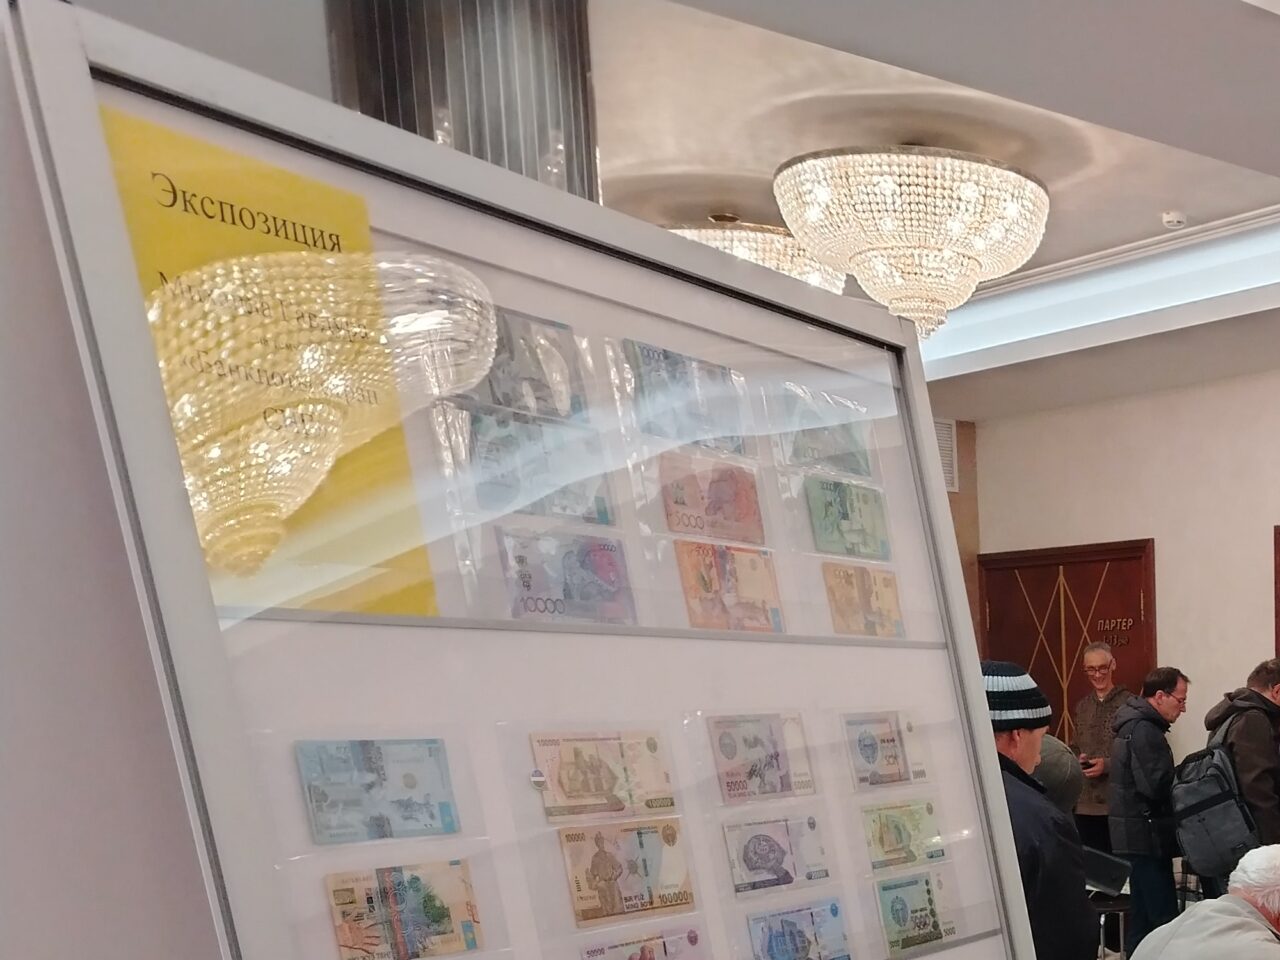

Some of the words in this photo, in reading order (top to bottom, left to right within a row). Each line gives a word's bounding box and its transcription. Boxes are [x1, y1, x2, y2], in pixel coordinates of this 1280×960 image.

[151, 172, 342, 252] Экспозиция
[520, 596, 566, 615] 10000
[1097, 618, 1134, 632] ПАРТЕР
[726, 780, 748, 792] 50000
